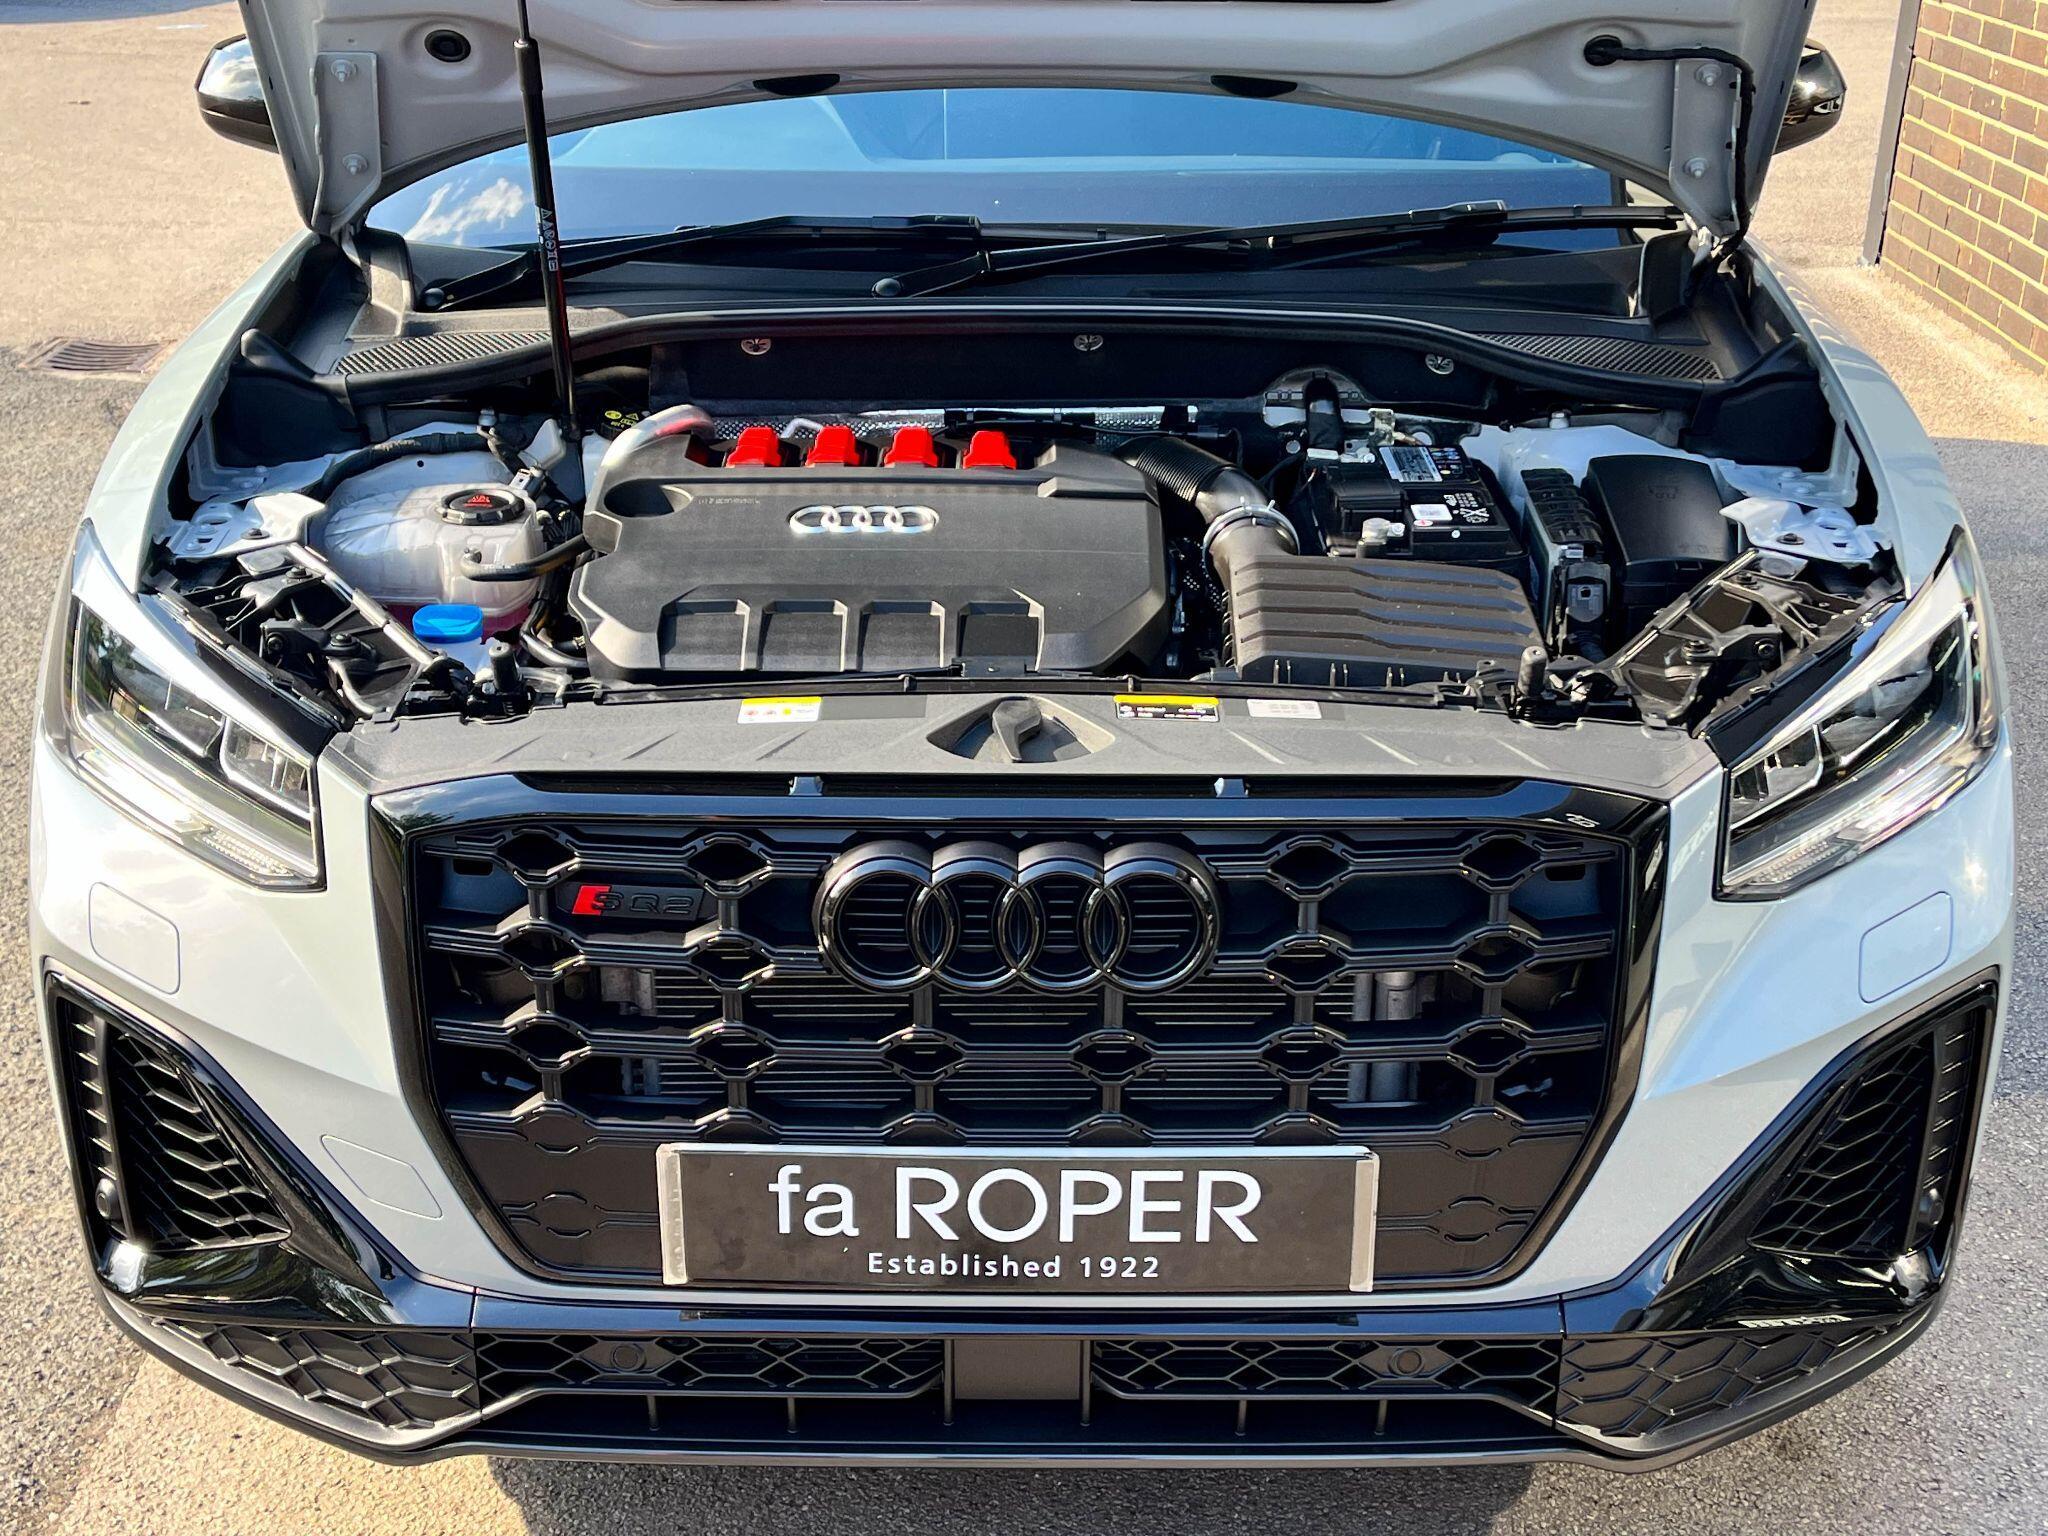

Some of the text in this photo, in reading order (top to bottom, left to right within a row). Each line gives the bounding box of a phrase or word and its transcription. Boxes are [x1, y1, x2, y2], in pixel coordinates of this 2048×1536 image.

[591, 891, 695, 914] SQ2
[769, 1165, 1261, 1242] fa ROPER
[869, 1253, 1159, 1278] Established 1922
